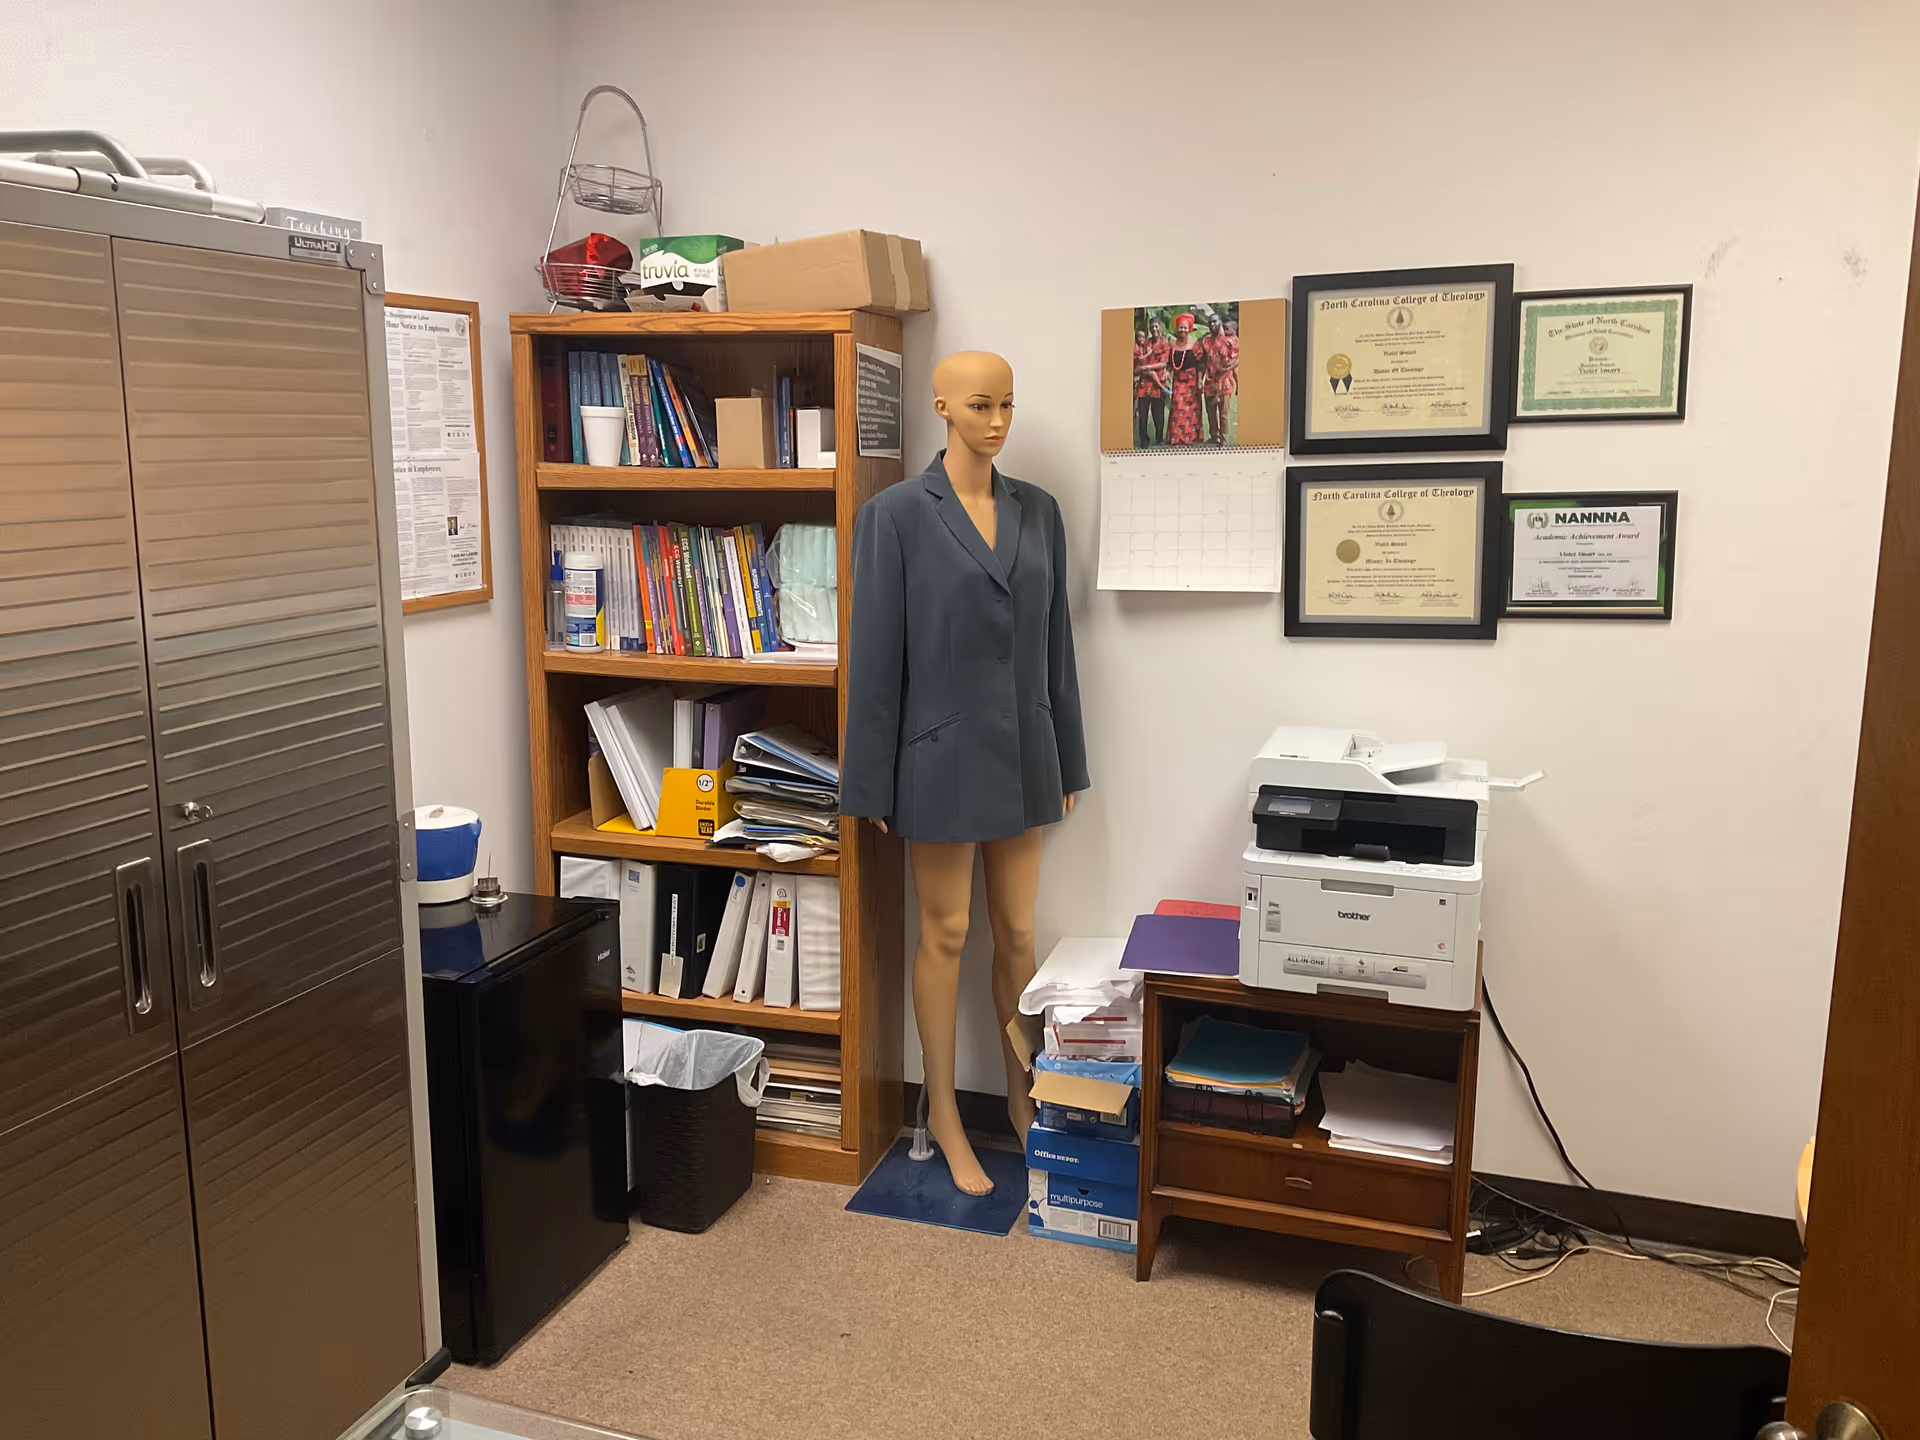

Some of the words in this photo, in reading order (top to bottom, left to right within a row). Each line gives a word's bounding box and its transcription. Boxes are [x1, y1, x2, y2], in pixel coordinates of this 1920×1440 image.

[1320, 300, 1348, 310] North
[1351, 298, 1390, 308] Carolina
[1393, 295, 1427, 306] College
[1430, 294, 1438, 302] of
[1442, 292, 1485, 302] Theology
[424, 324, 450, 333] Employees
[1548, 329, 1562, 337] The
[1564, 320, 1585, 330] State
[1596, 316, 1618, 326] North
[1620, 320, 1650, 335] Carolina
[414, 465, 441, 474] Employees
[1312, 492, 1340, 501] North
[1343, 490, 1381, 500] Carolina
[1384, 490, 1418, 499] College
[1420, 488, 1428, 497] of
[1432, 488, 1474, 498] Theology
[1555, 512, 1630, 524] NANNNA
[683, 550, 692, 579] Workout
[752, 568, 760, 589] NURSING
[755, 590, 764, 616] ASSISTANTS
[1338, 910, 1371, 921] brother
[1287, 956, 1324, 966] ALL-IN-ONE
[1034, 1150, 1056, 1159] Office
[1050, 1194, 1103, 1208] multipurpose
